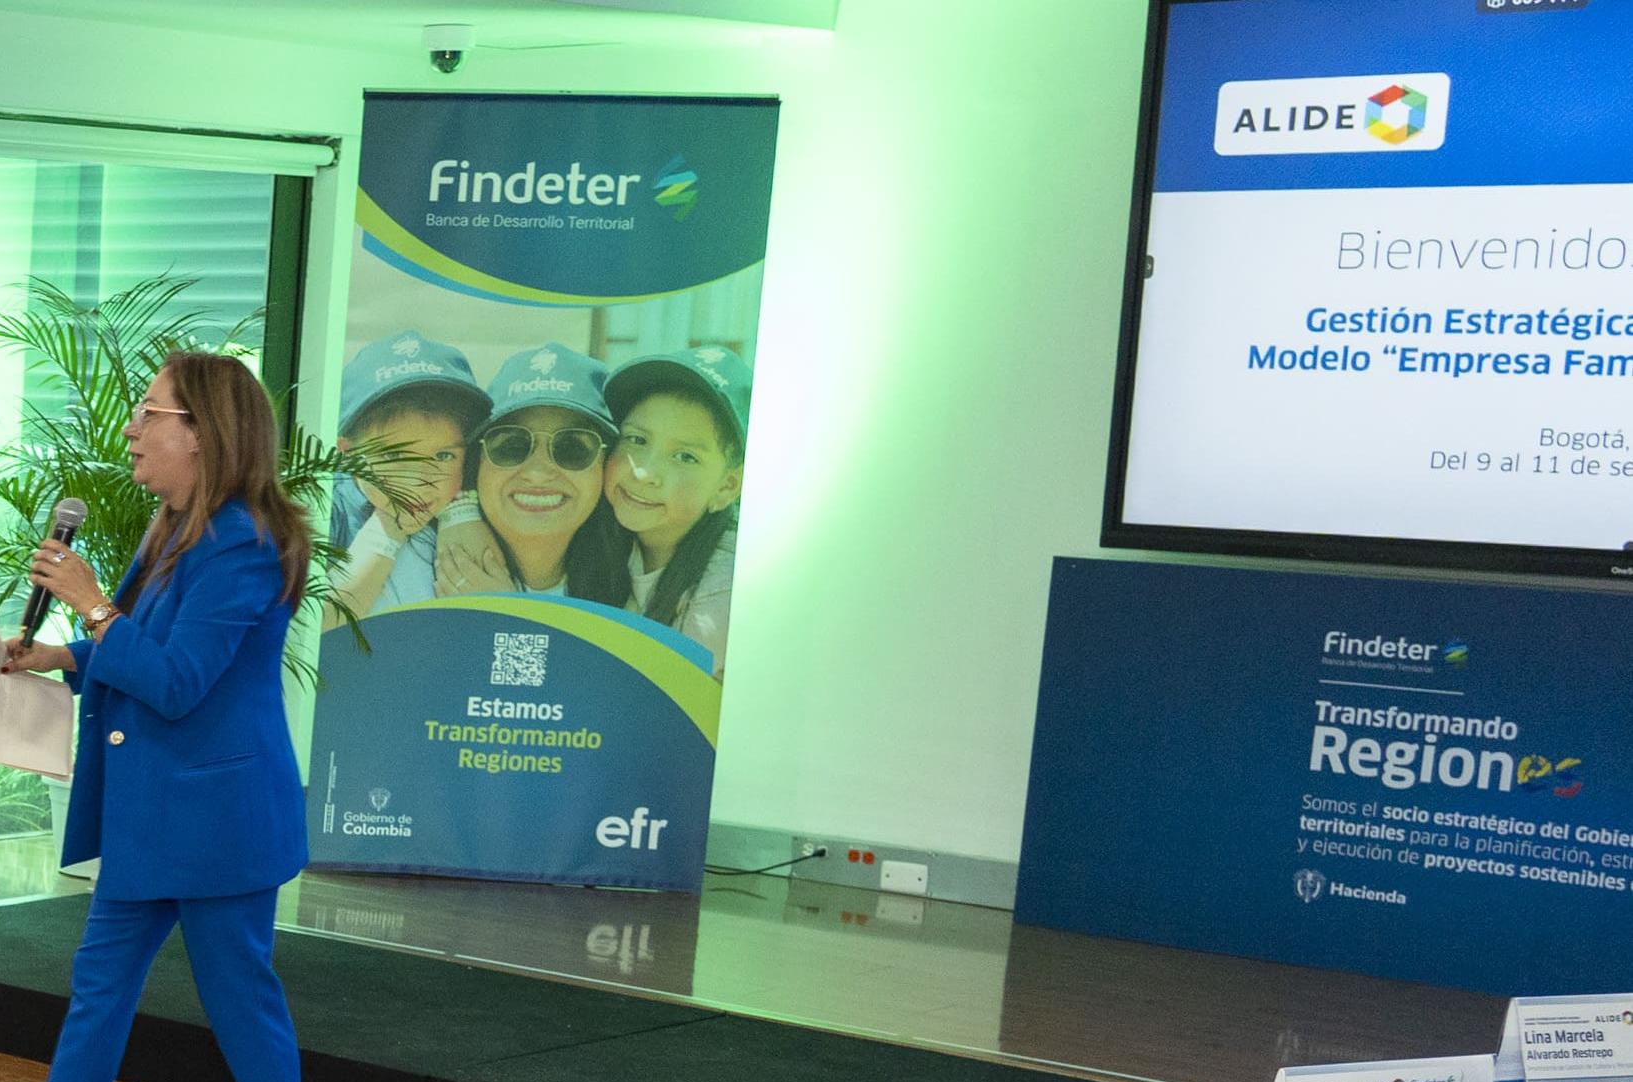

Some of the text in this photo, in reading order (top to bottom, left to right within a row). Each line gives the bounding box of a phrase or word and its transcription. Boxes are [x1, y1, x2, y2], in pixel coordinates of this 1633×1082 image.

[1234, 104, 1355, 134] ALIDE
[429, 160, 641, 205] Findeter
[427, 214, 633, 231] Banca de Desarrollo Territorial
[1337, 228, 1633, 270] Bienvenido
[1306, 307, 1432, 335] Gestión
[1248, 344, 1370, 372] Modelo
[1539, 428, 1631, 451] Bogotá,
[1431, 451, 1466, 471] Del
[1477, 453, 1491, 472] 9
[1500, 453, 1519, 473] al
[1533, 455, 1559, 474] 11
[1571, 456, 1600, 476] de
[1323, 631, 1438, 661] Findeter
[467, 697, 563, 721] Estamos
[1315, 700, 1518, 741] Transformando
[425, 720, 602, 749] Transformando
[458, 748, 562, 774] Regiones
[342, 823, 412, 837] Colombia
[344, 811, 413, 825] Gobierno de
[596, 807, 667, 850] efr
[1302, 794, 1356, 816] Somos
[1362, 801, 1376, 817] el
[1383, 805, 1430, 824] socio
[1434, 809, 1535, 836] estratégico
[1540, 821, 1569, 840] del
[1299, 815, 1405, 842] territoriales
[1410, 829, 1448, 848] para
[1455, 832, 1469, 849] la
[1297, 837, 1625, 891] y ejecución de proyectos sostenibles
[1330, 881, 1406, 904] Hacienda
[1525, 1029, 1604, 1044] Lina Marcela
[1527, 1048, 1613, 1060] Alvarado Restrepo
